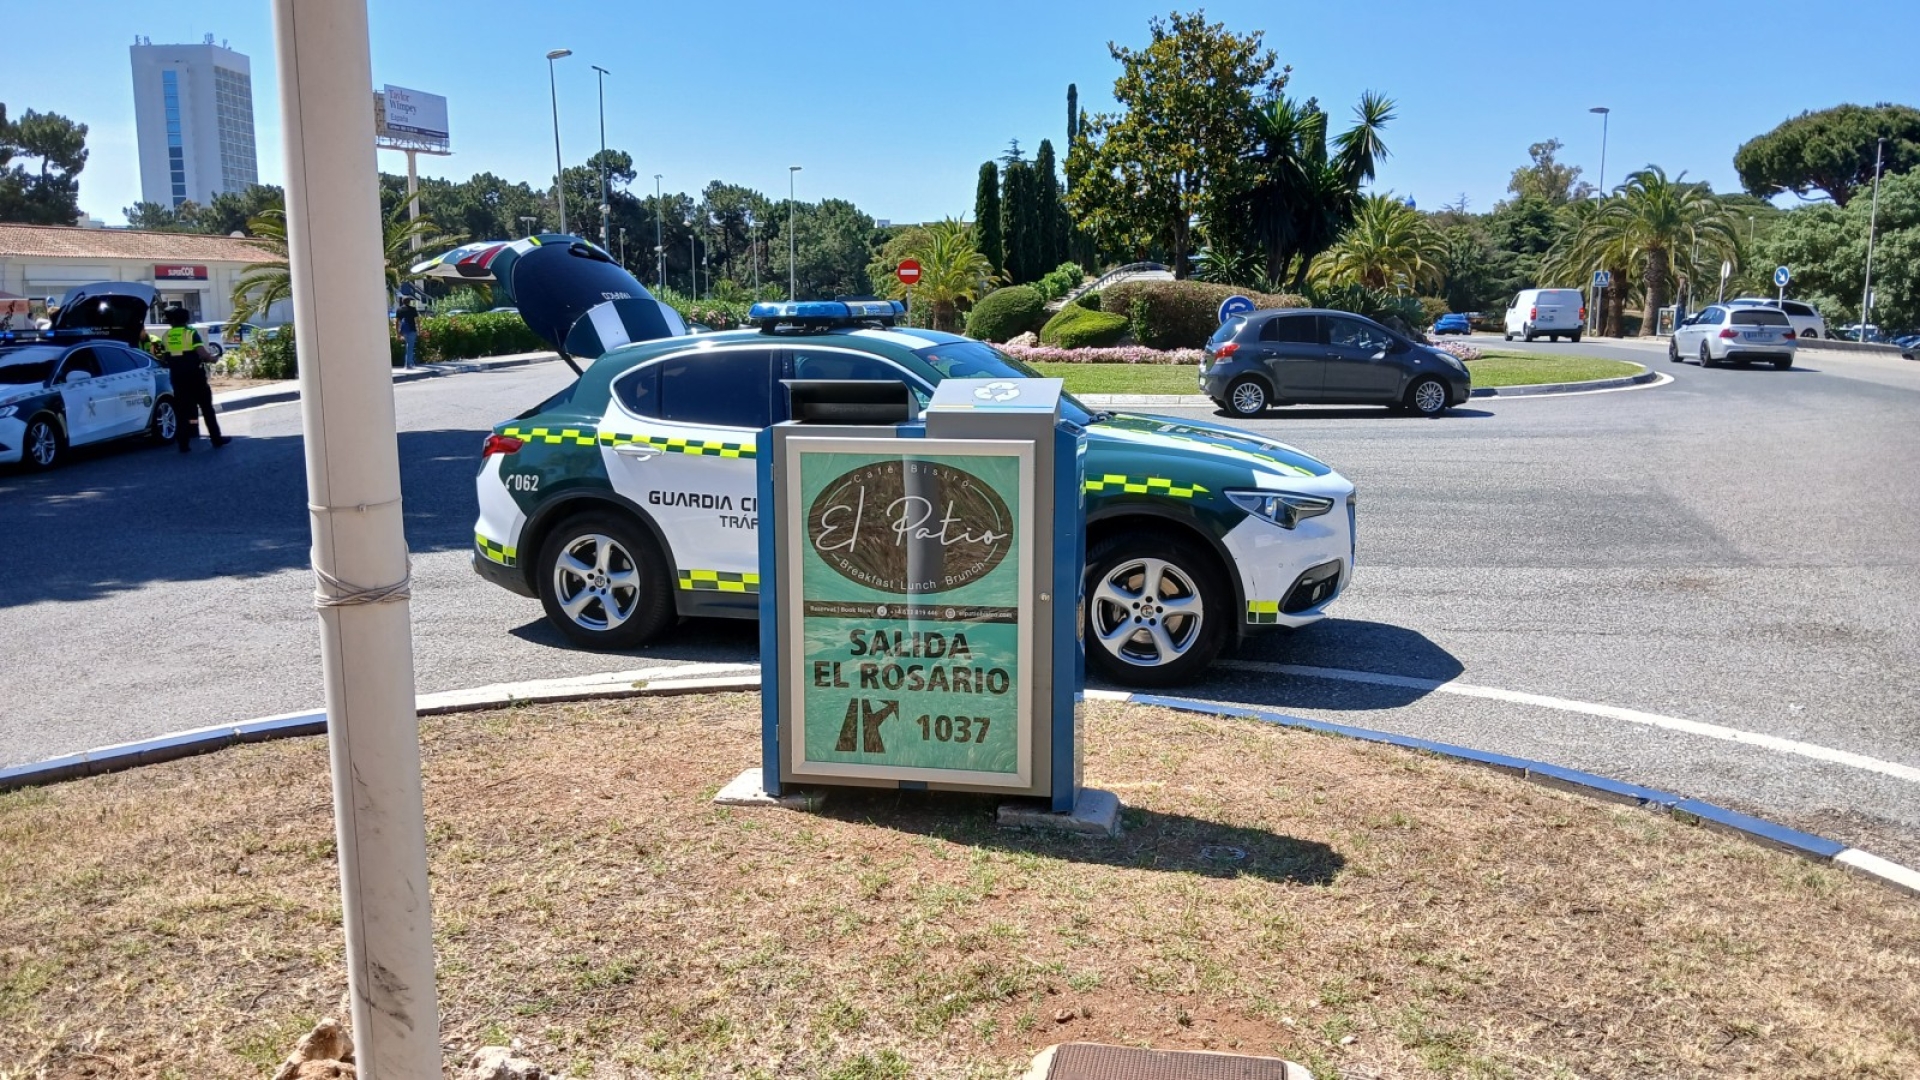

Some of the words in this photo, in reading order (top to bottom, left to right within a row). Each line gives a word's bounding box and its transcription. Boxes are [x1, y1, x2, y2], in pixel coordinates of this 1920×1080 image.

[389, 99, 417, 116] Wimpey
[515, 474, 540, 491] 062
[648, 490, 733, 511] GUARDIA
[719, 513, 759, 530] TRÁF
[815, 485, 865, 552] El
[886, 495, 1009, 546] Patio
[839, 558, 894, 589] Breakfast
[900, 580, 937, 590] Lunch
[945, 562, 986, 586] Brunch
[850, 628, 973, 660] SALIDA
[814, 661, 849, 689] EL
[860, 663, 1010, 694] ROSARIO
[916, 714, 991, 744] 1037
